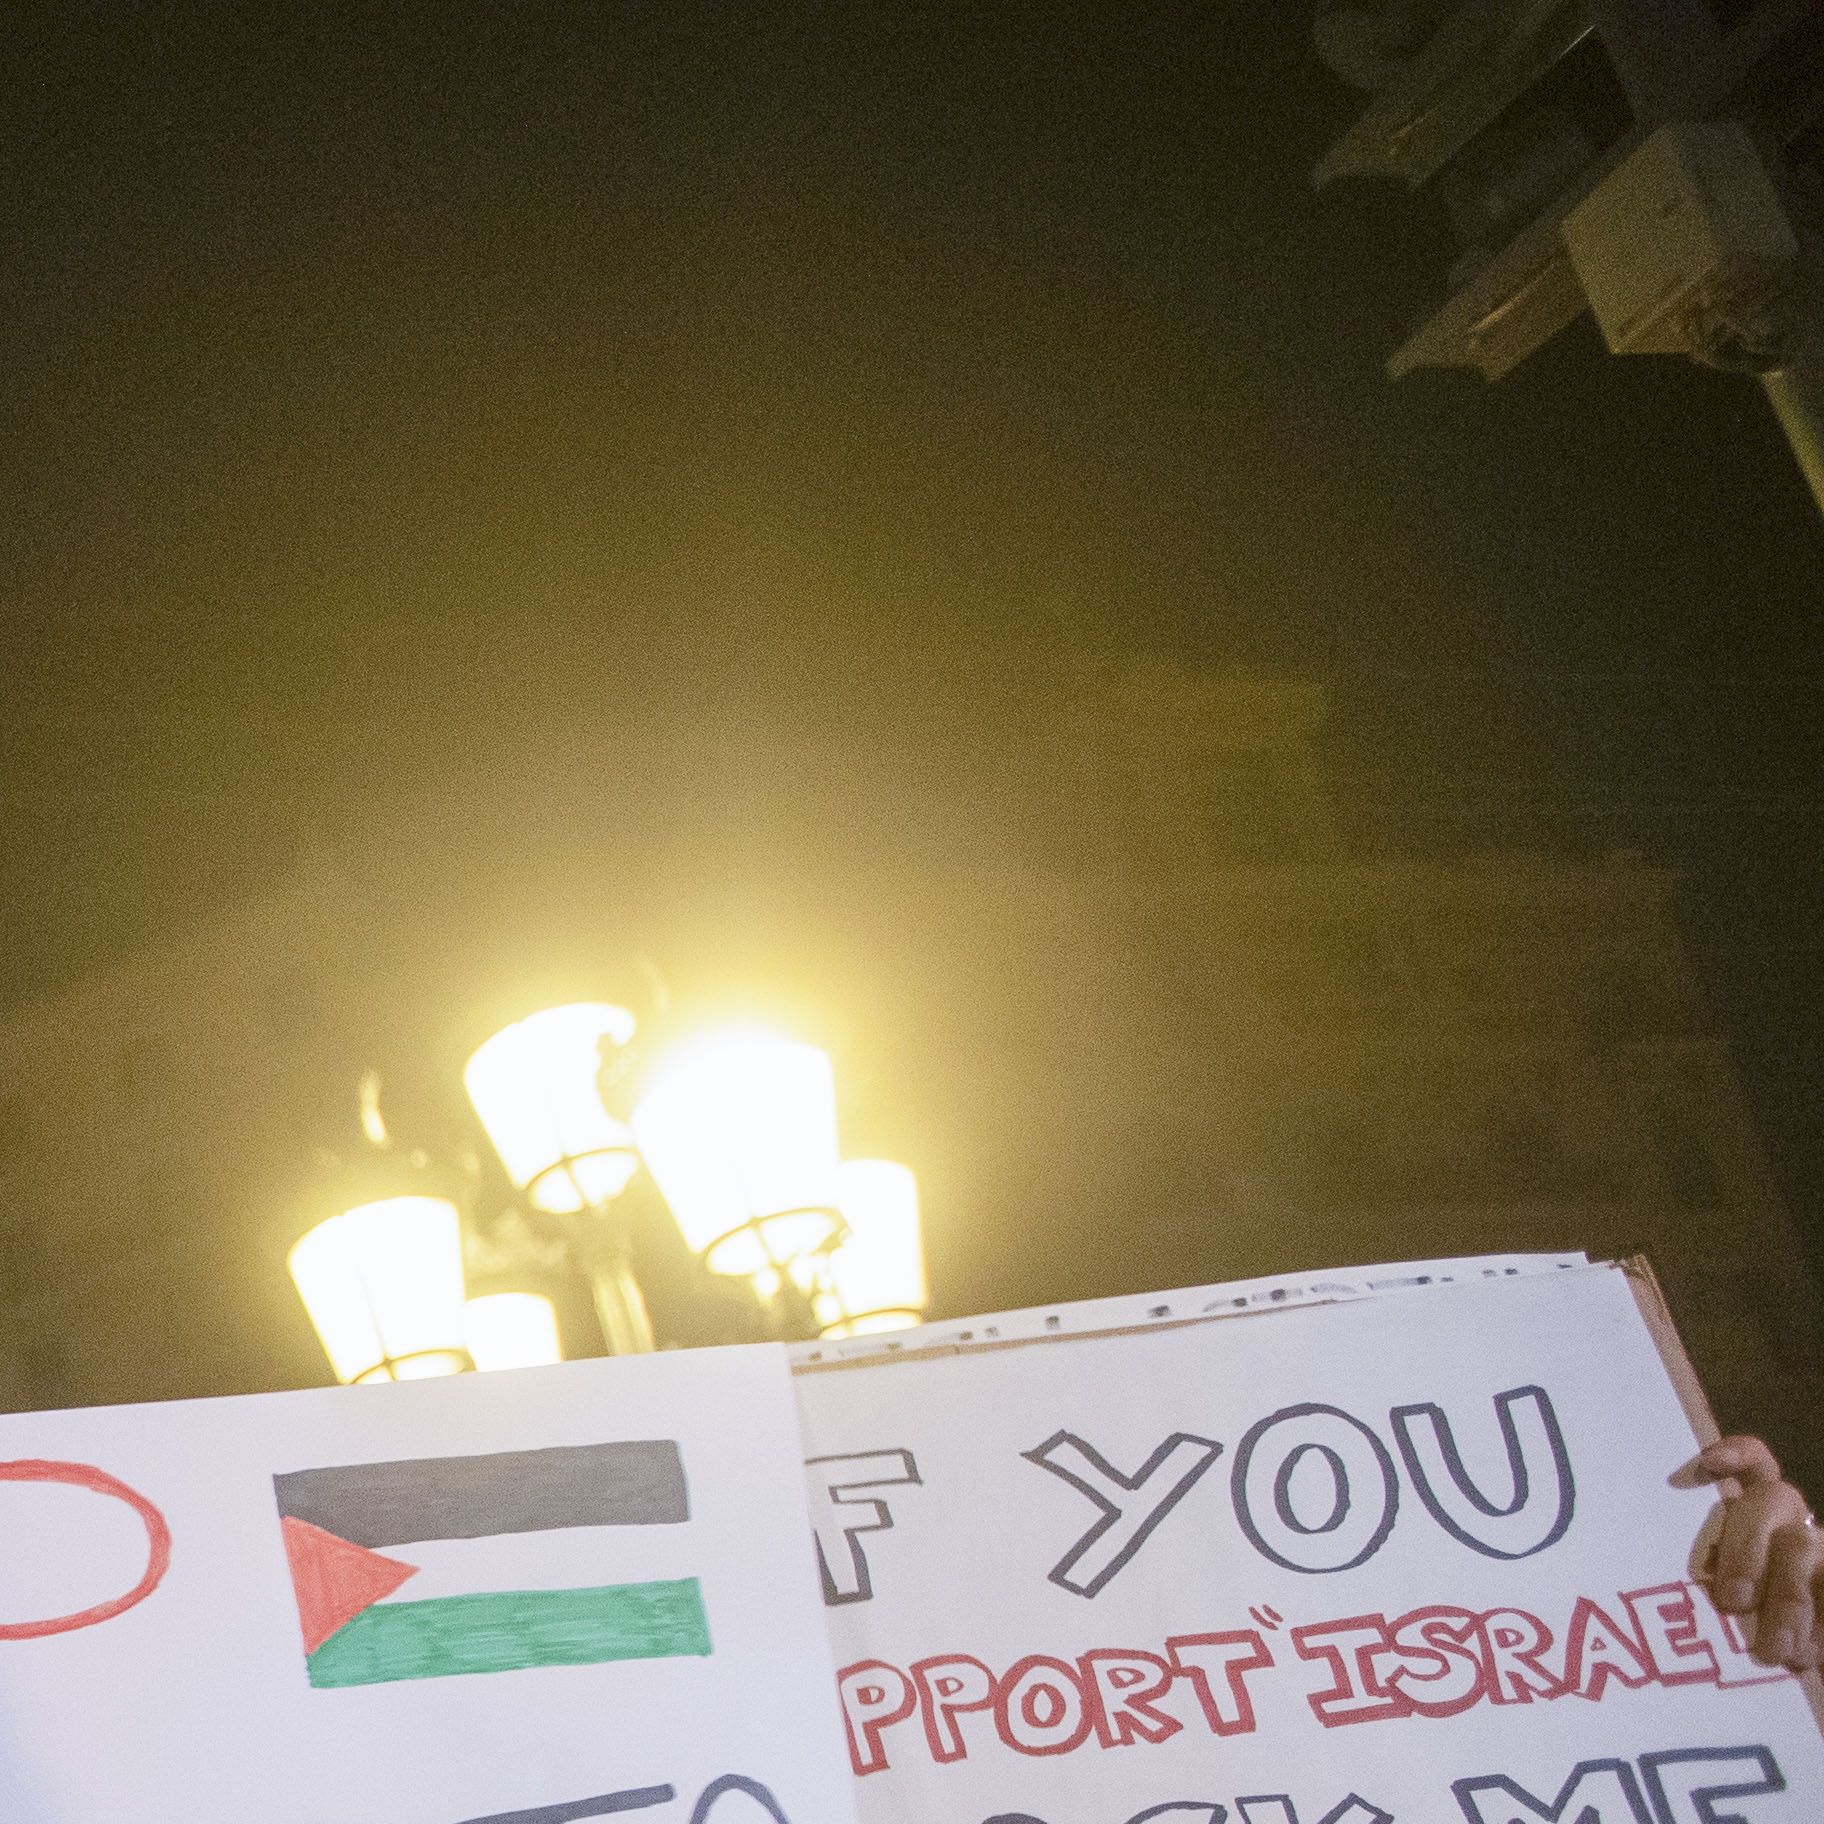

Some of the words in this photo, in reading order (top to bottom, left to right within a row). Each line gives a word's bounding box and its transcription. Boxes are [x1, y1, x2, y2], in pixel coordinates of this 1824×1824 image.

[802, 1446, 924, 1607] F
[1019, 1382, 1576, 1599] YOU
[835, 1628, 1274, 1777] PPORT
